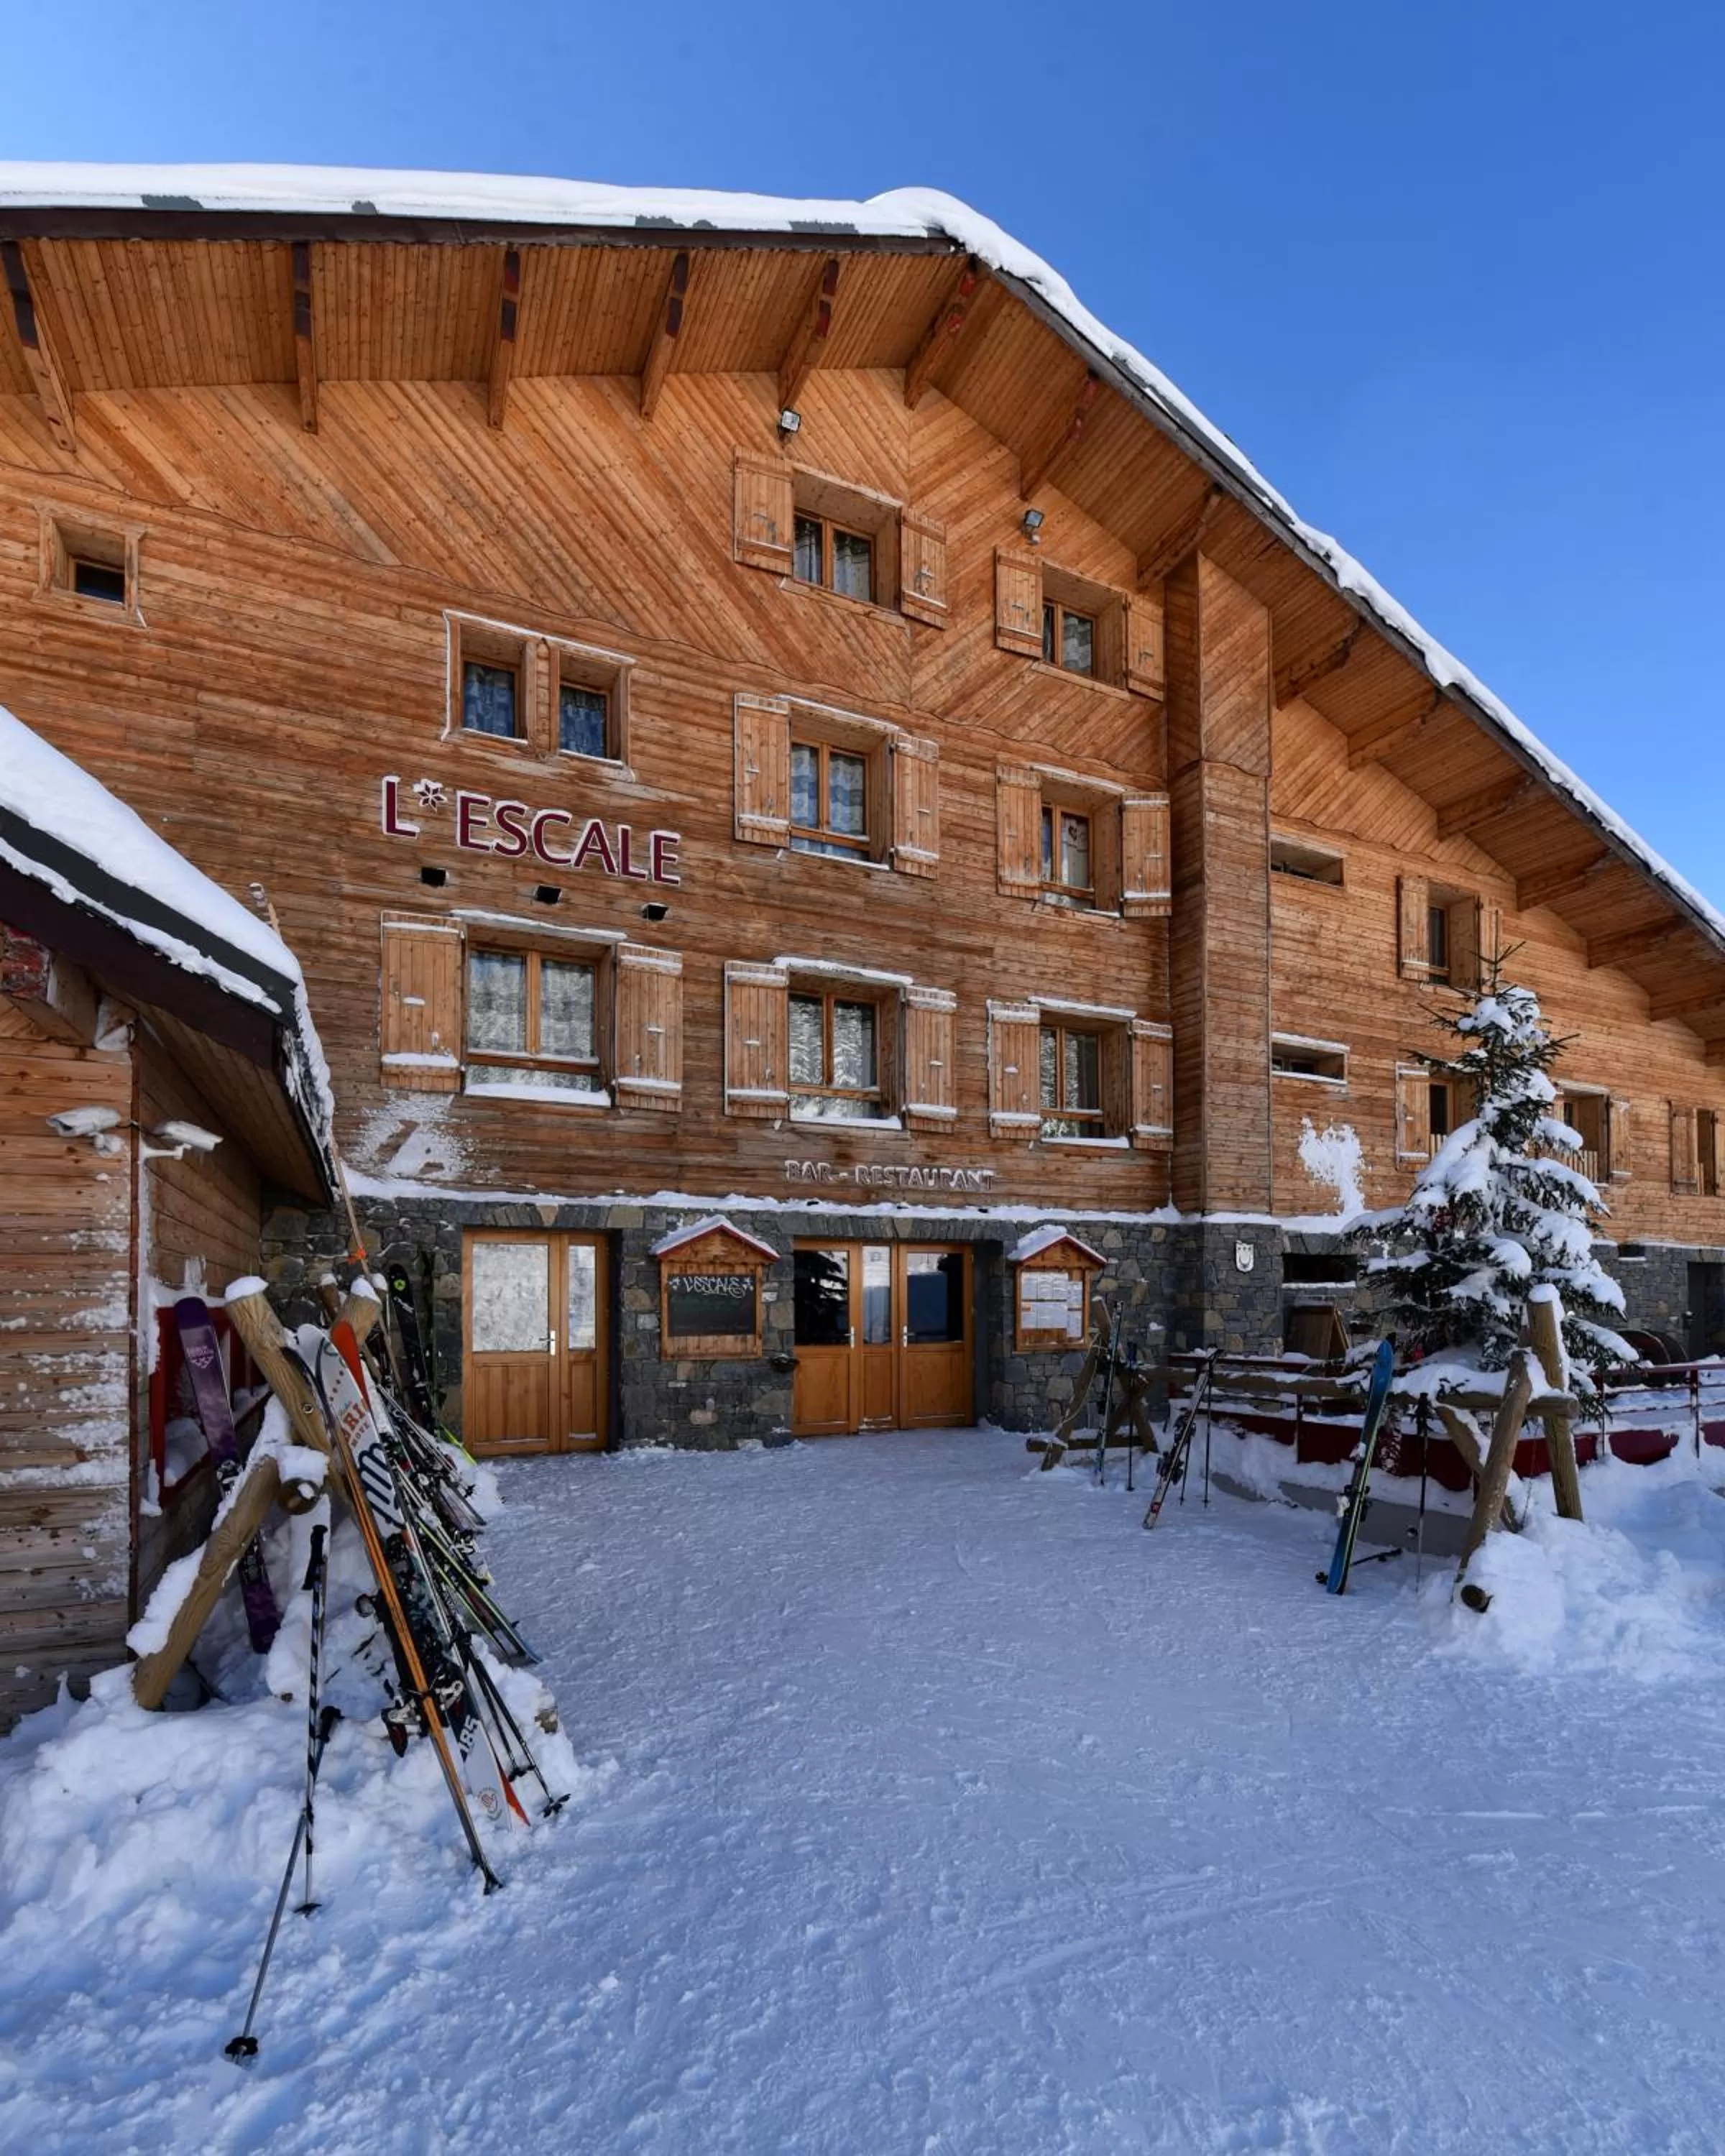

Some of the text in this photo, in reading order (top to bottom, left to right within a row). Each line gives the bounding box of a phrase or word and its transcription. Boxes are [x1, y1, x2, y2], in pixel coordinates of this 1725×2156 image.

[784, 1159, 834, 1182] BAR
[855, 1165, 996, 1190] RESTAURANT
[458, 1714, 481, 1752] 185
